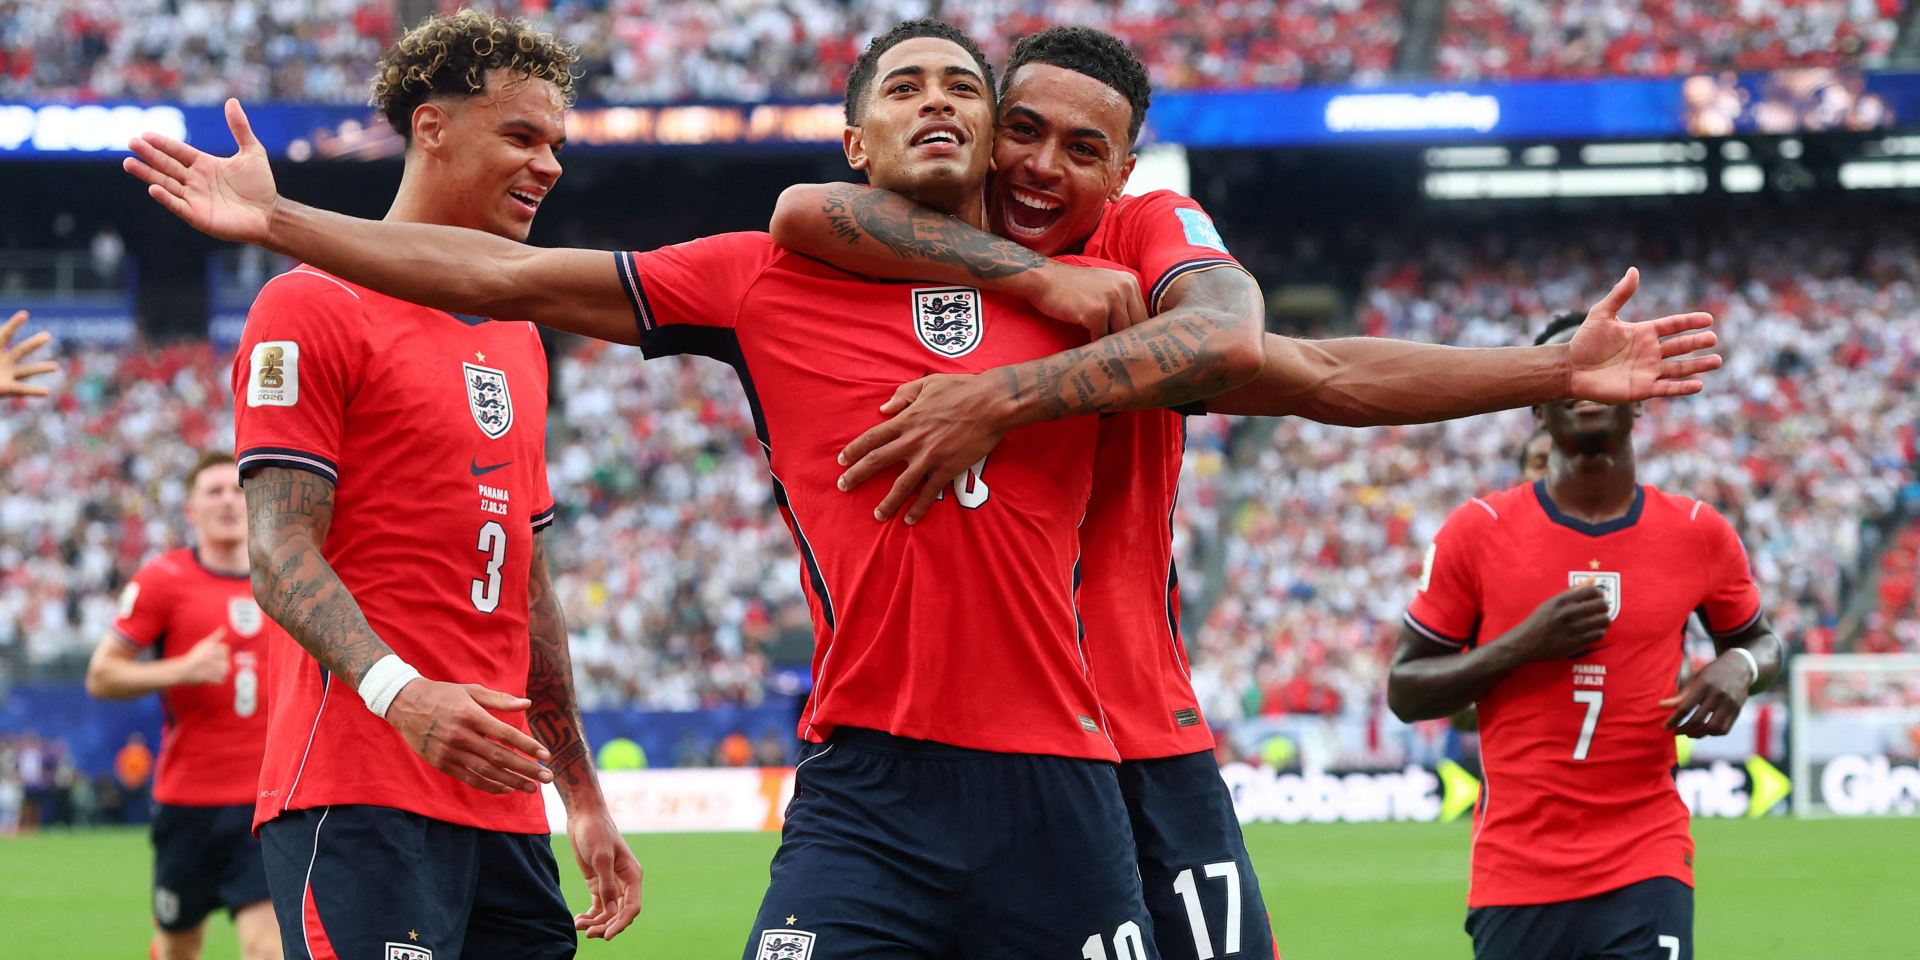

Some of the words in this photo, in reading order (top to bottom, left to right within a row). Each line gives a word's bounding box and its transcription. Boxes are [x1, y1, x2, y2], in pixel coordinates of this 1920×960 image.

[478, 484, 509, 501] PANAMA
[470, 520, 507, 614] 3
[1572, 690, 1603, 760] 7
[1172, 860, 1242, 960] 17
